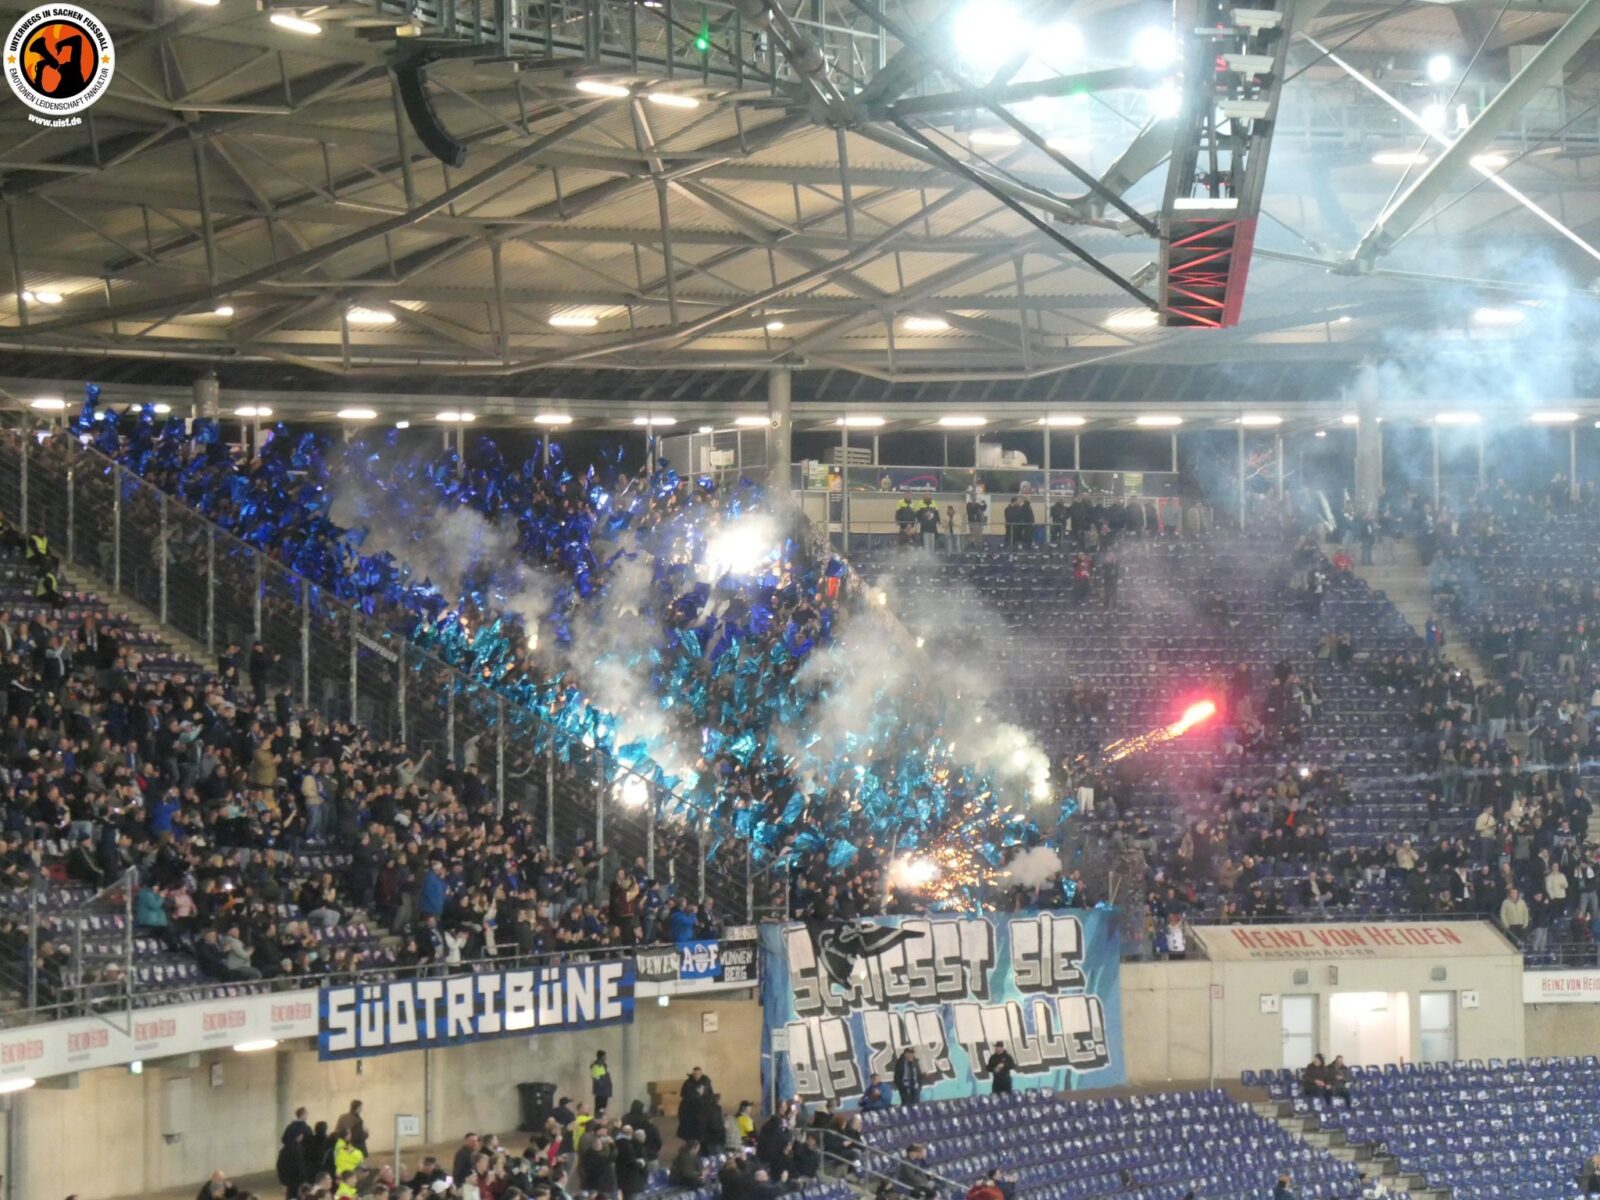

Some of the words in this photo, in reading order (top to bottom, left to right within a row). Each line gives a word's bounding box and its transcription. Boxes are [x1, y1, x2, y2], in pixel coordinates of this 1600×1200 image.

[1010, 914, 1086, 992] SIE
[1231, 928, 1313, 949] HEINZ
[1311, 928, 1366, 947] VON
[1364, 926, 1463, 946] HEIDEN
[328, 962, 623, 1051] SÜDTRIBÜNE
[787, 1017, 861, 1100] BIS
